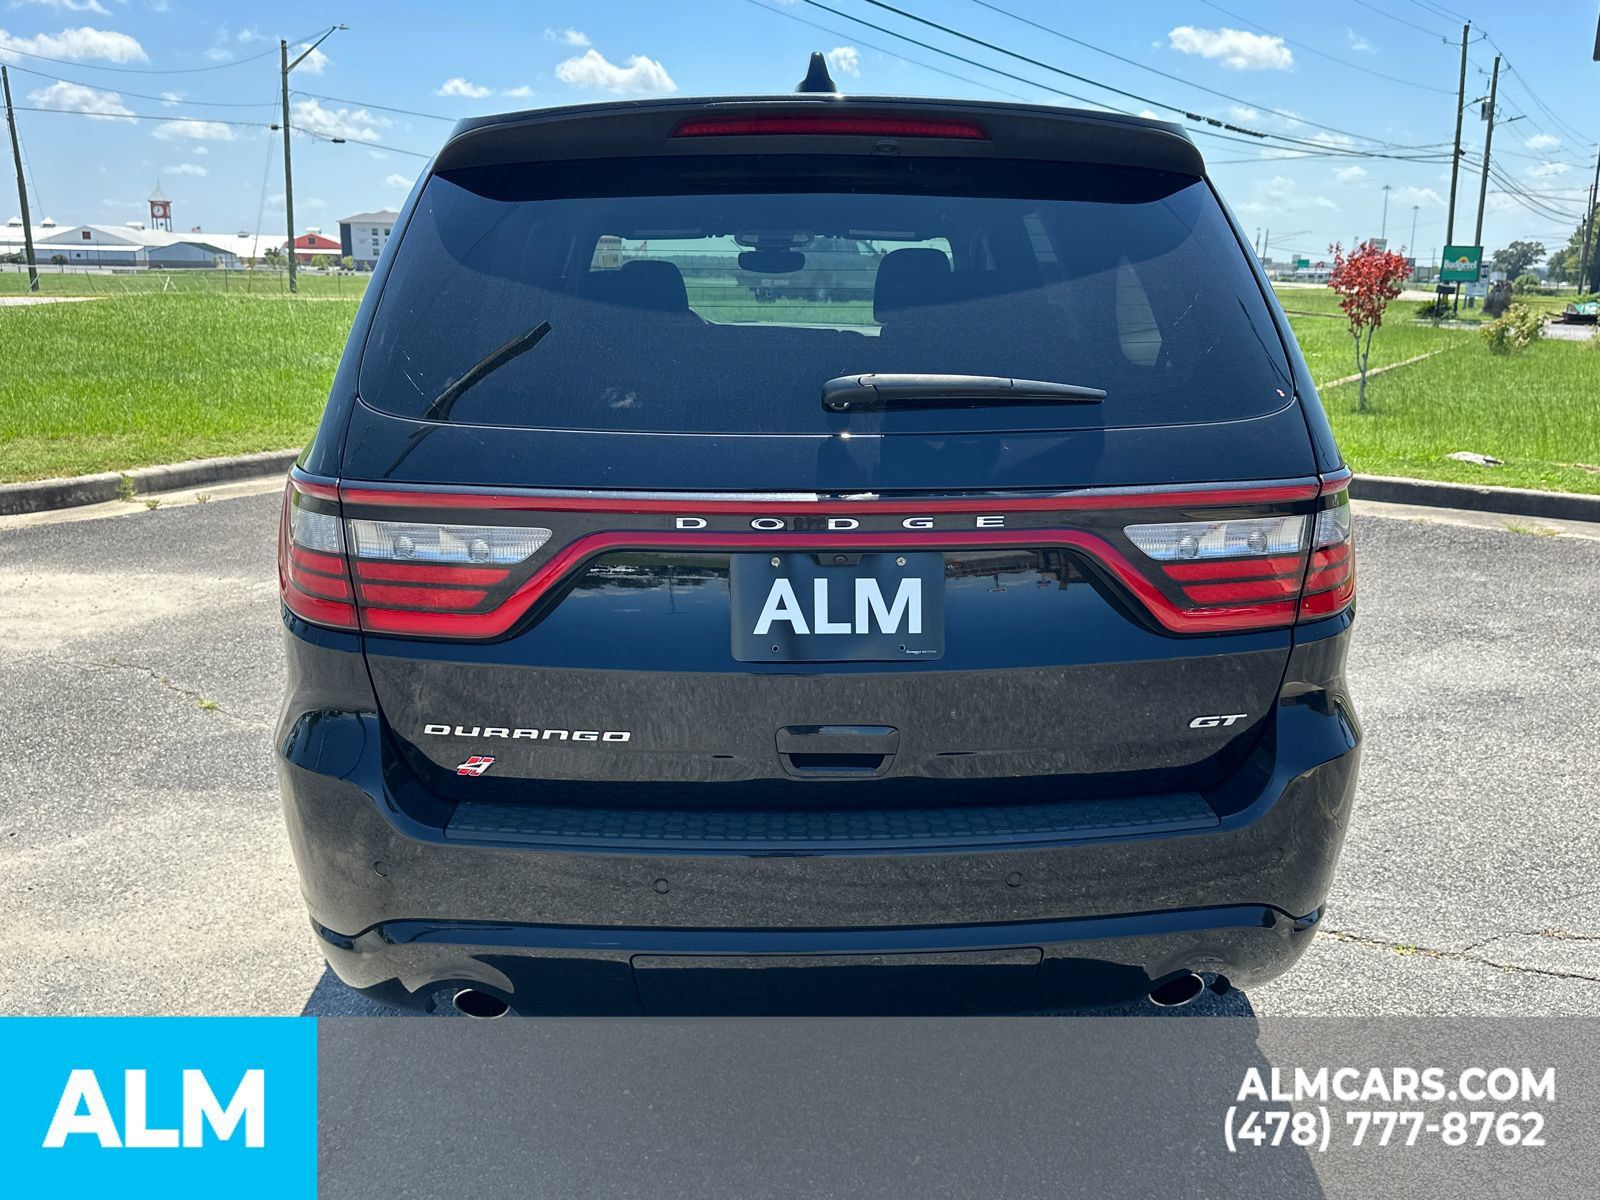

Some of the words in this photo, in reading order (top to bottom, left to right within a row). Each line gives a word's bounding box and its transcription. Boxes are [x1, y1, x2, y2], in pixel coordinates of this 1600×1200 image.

[676, 516, 1005, 530] DODGE
[753, 577, 922, 635] ALM
[1189, 713, 1248, 728] GT
[423, 724, 632, 742] DURANGO
